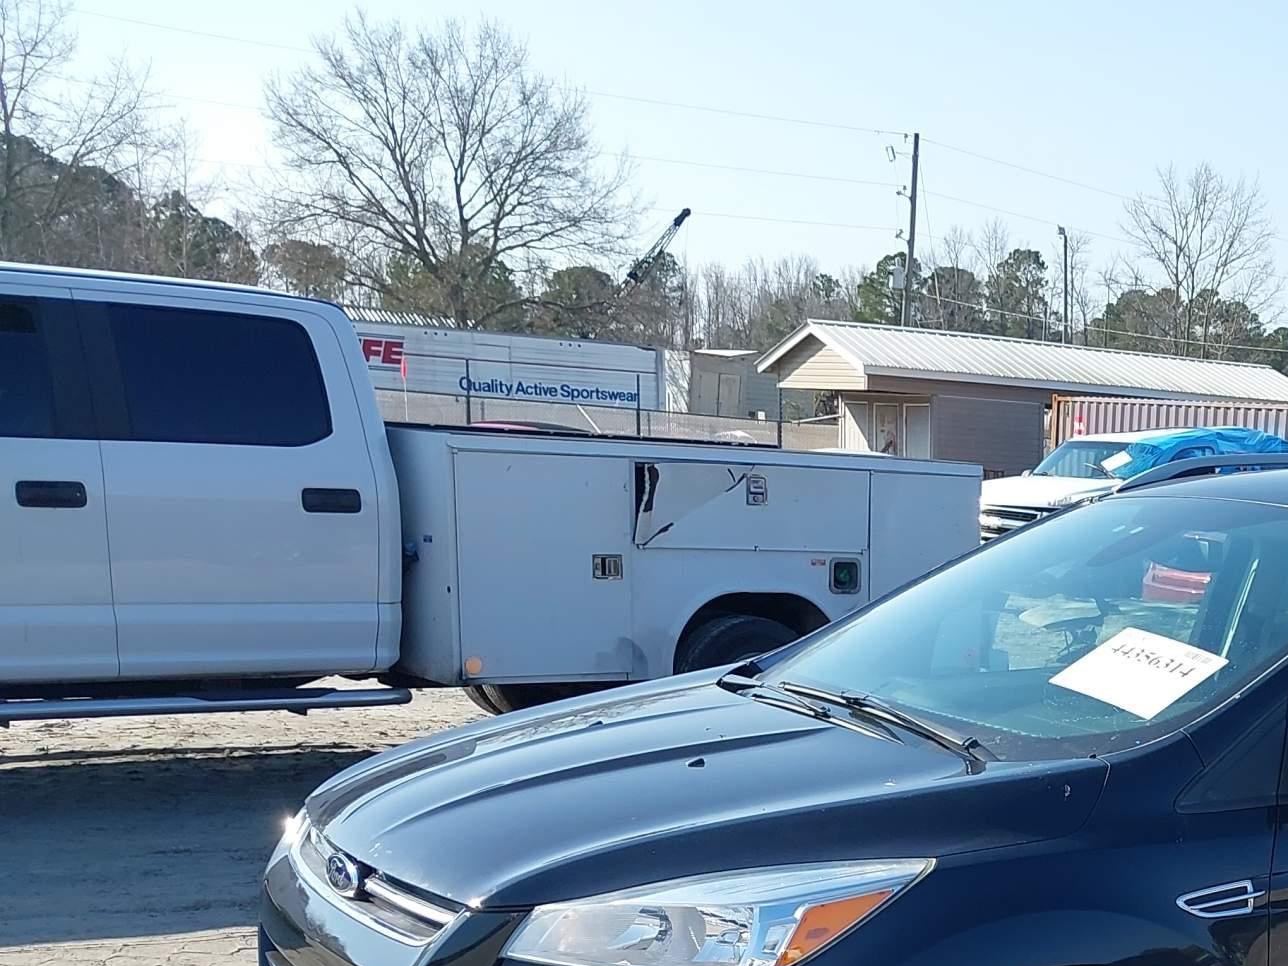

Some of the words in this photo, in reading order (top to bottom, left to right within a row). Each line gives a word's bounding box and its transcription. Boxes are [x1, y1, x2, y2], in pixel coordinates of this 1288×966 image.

[359, 338, 404, 365] FE
[459, 376, 513, 396] Quality
[515, 381, 558, 397] Active
[560, 384, 639, 402] Sportswear
[1111, 643, 1197, 678] 44356314
